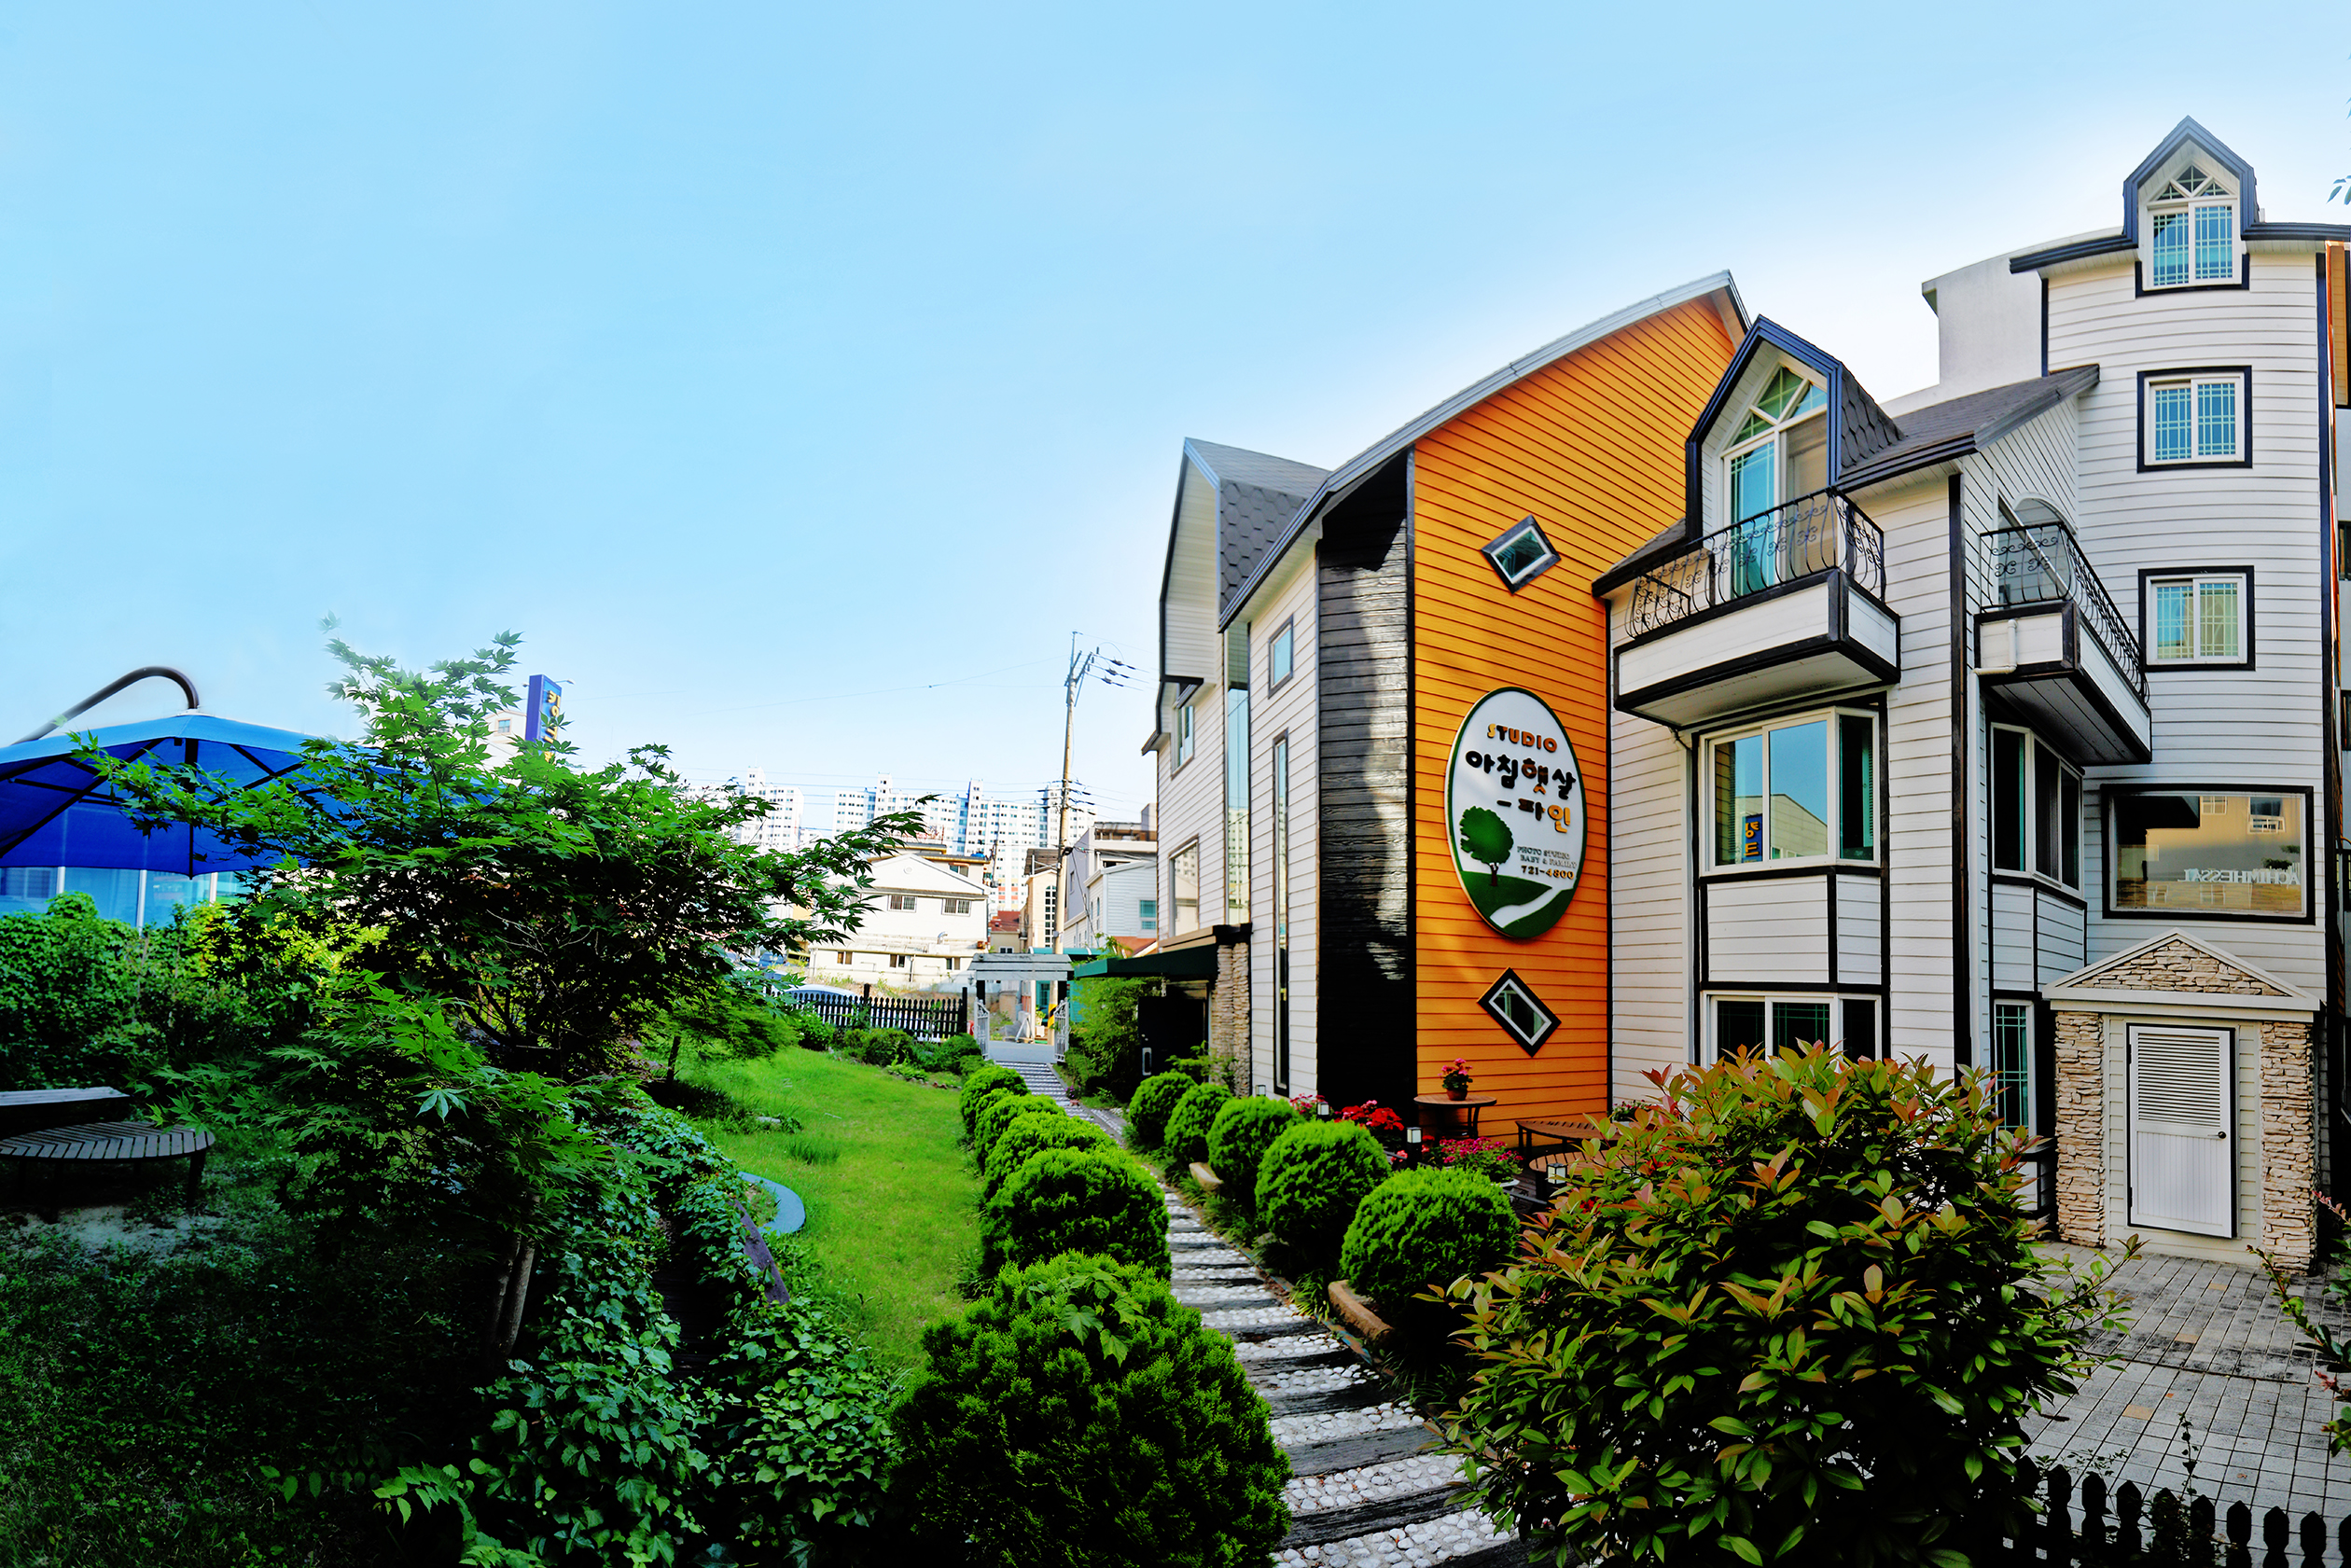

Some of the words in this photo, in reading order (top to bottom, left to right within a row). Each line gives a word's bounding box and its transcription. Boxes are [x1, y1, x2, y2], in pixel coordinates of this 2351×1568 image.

[1487, 724, 1557, 753] STUDIO
[1466, 751, 1576, 799] 아침햇살
[1517, 846, 1542, 855] PHOTO
[1543, 850, 1570, 859] STUDIO
[1520, 854, 1540, 863] BABY
[1549, 858, 1577, 868] FAMILY
[1521, 865, 1574, 880] 721-4800
